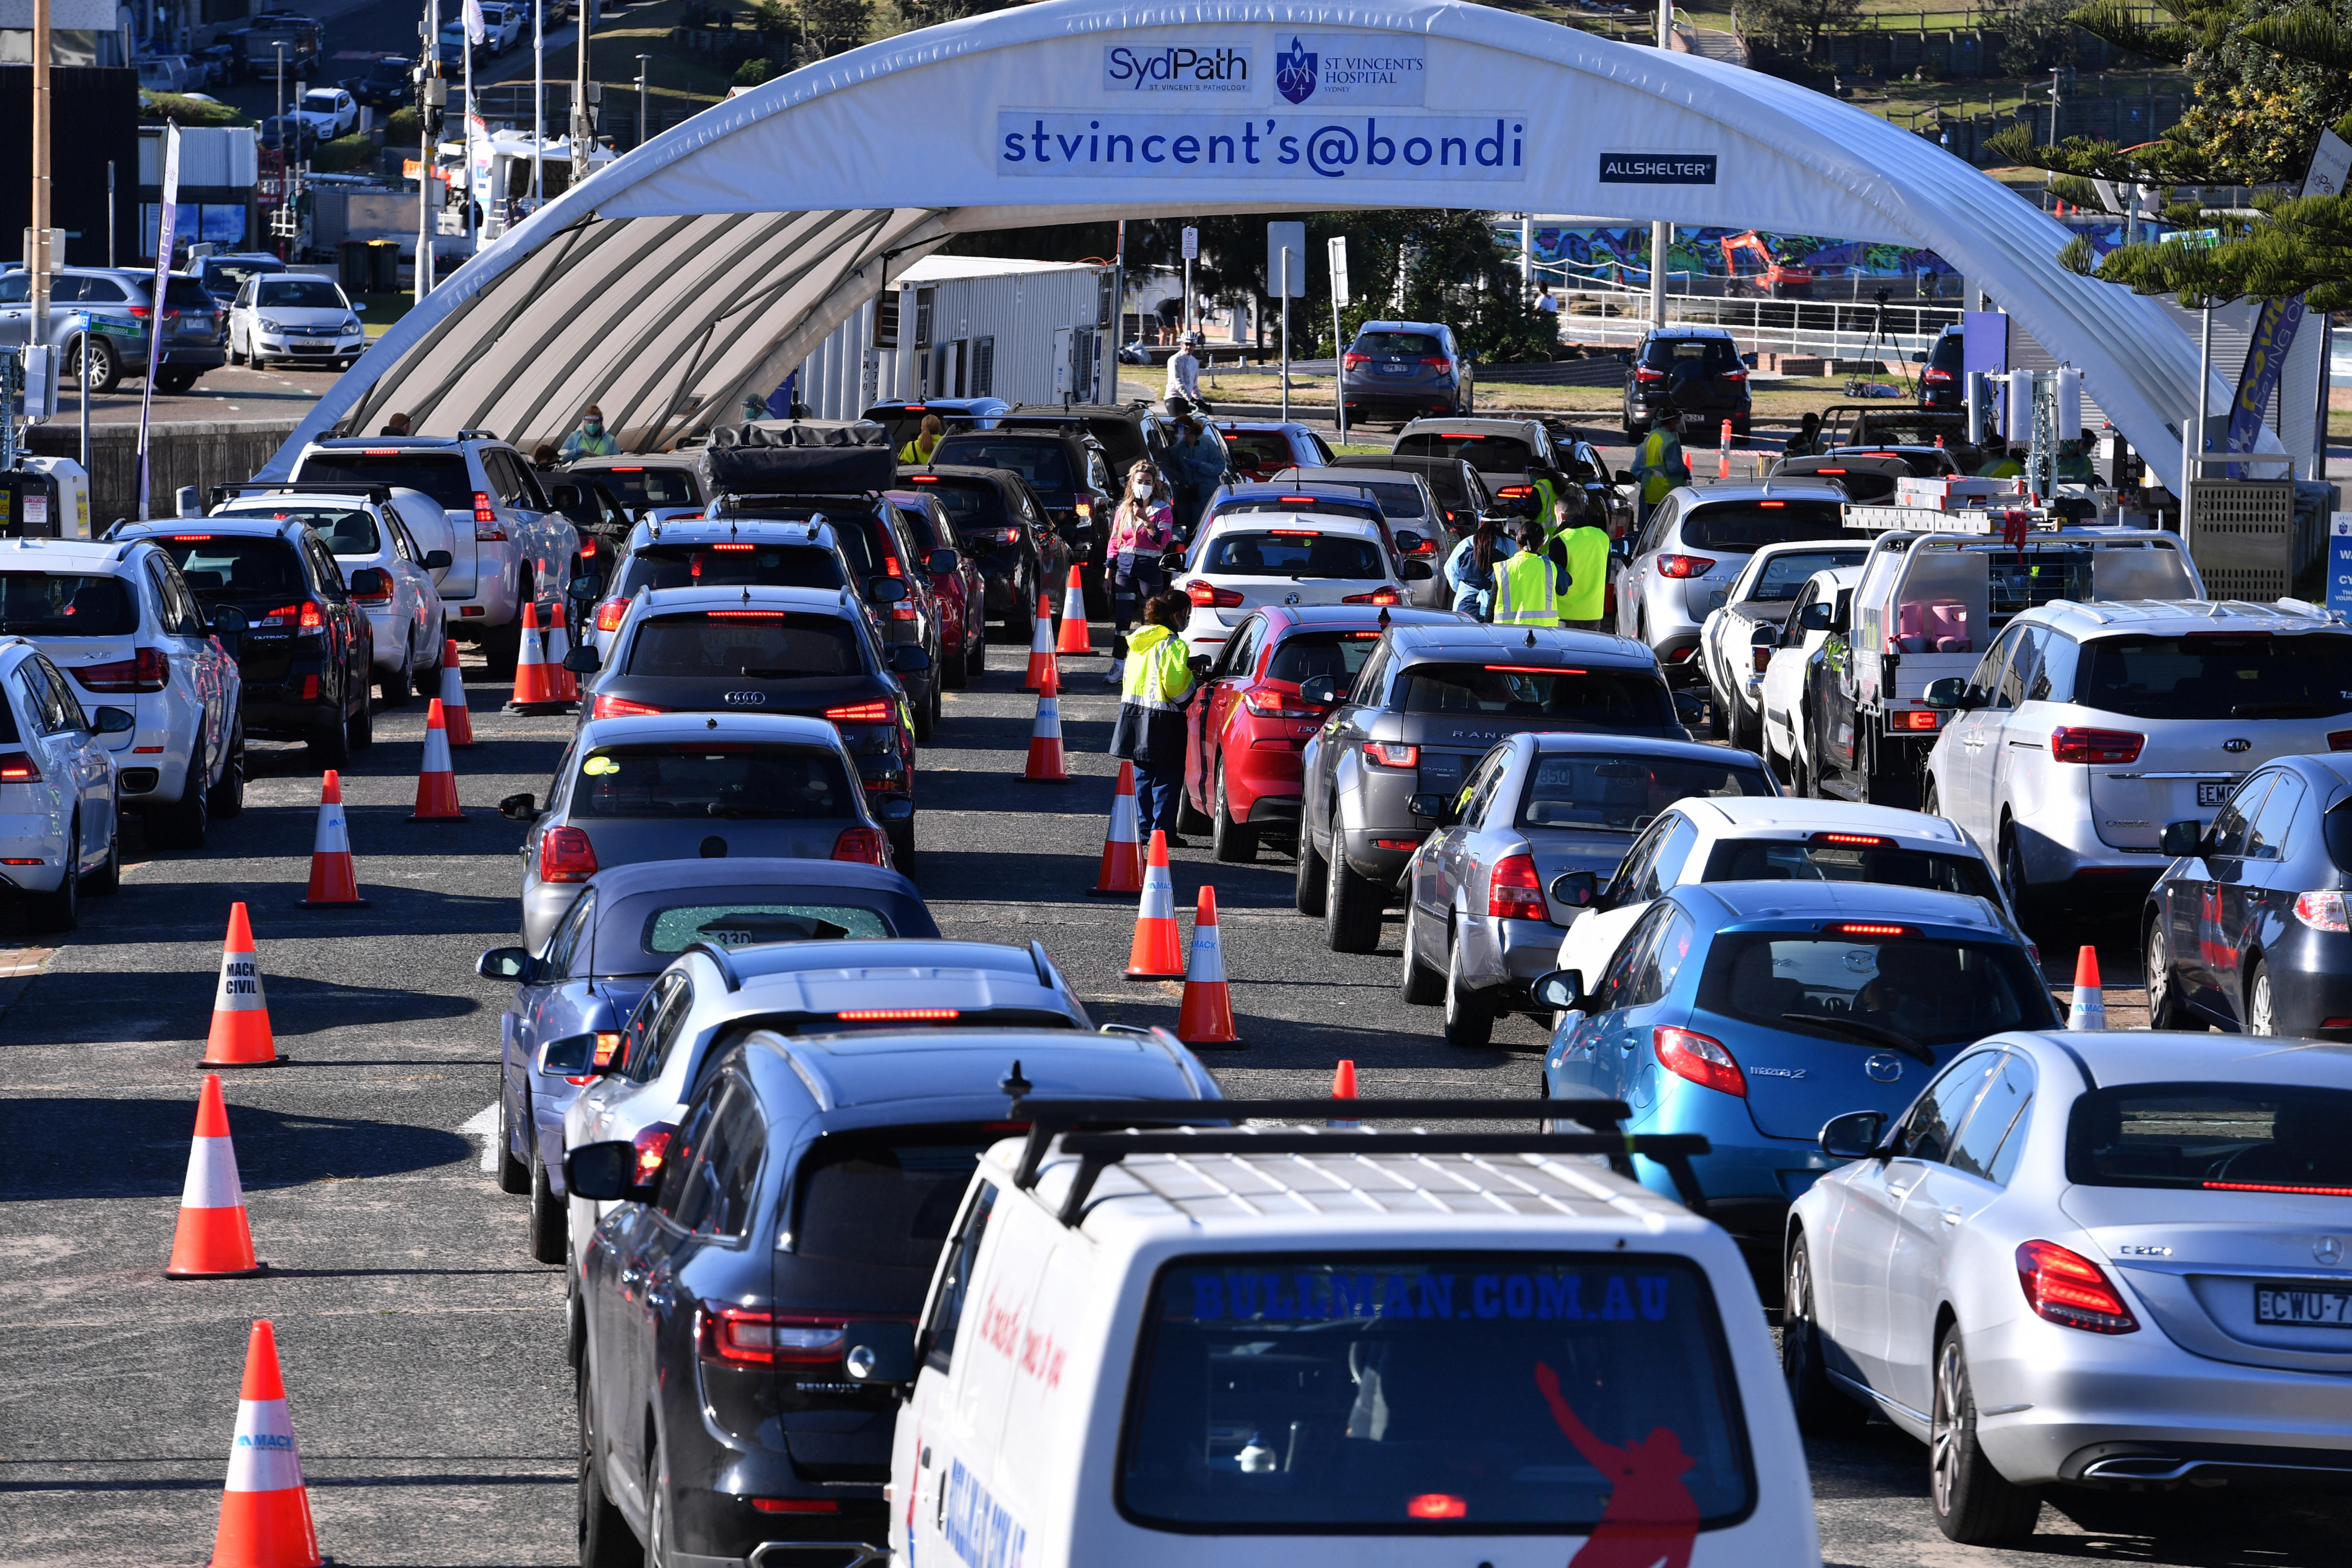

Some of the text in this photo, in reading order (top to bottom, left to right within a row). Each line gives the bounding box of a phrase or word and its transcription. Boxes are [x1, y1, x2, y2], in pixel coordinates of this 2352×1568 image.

[1109, 48, 1247, 89] SydPath
[1325, 57, 1423, 70] ST VINCENT'S
[1325, 72, 1397, 84] HOSPITAL
[1003, 118, 1522, 177] stvincent's@bondi
[1453, 731, 1513, 740] RANG
[2227, 740, 2248, 750] KIA
[227, 963, 256, 977] MACK
[226, 980, 256, 994] CIVIL
[1192, 1274, 1669, 1321] BULLMAN.COM.AU
